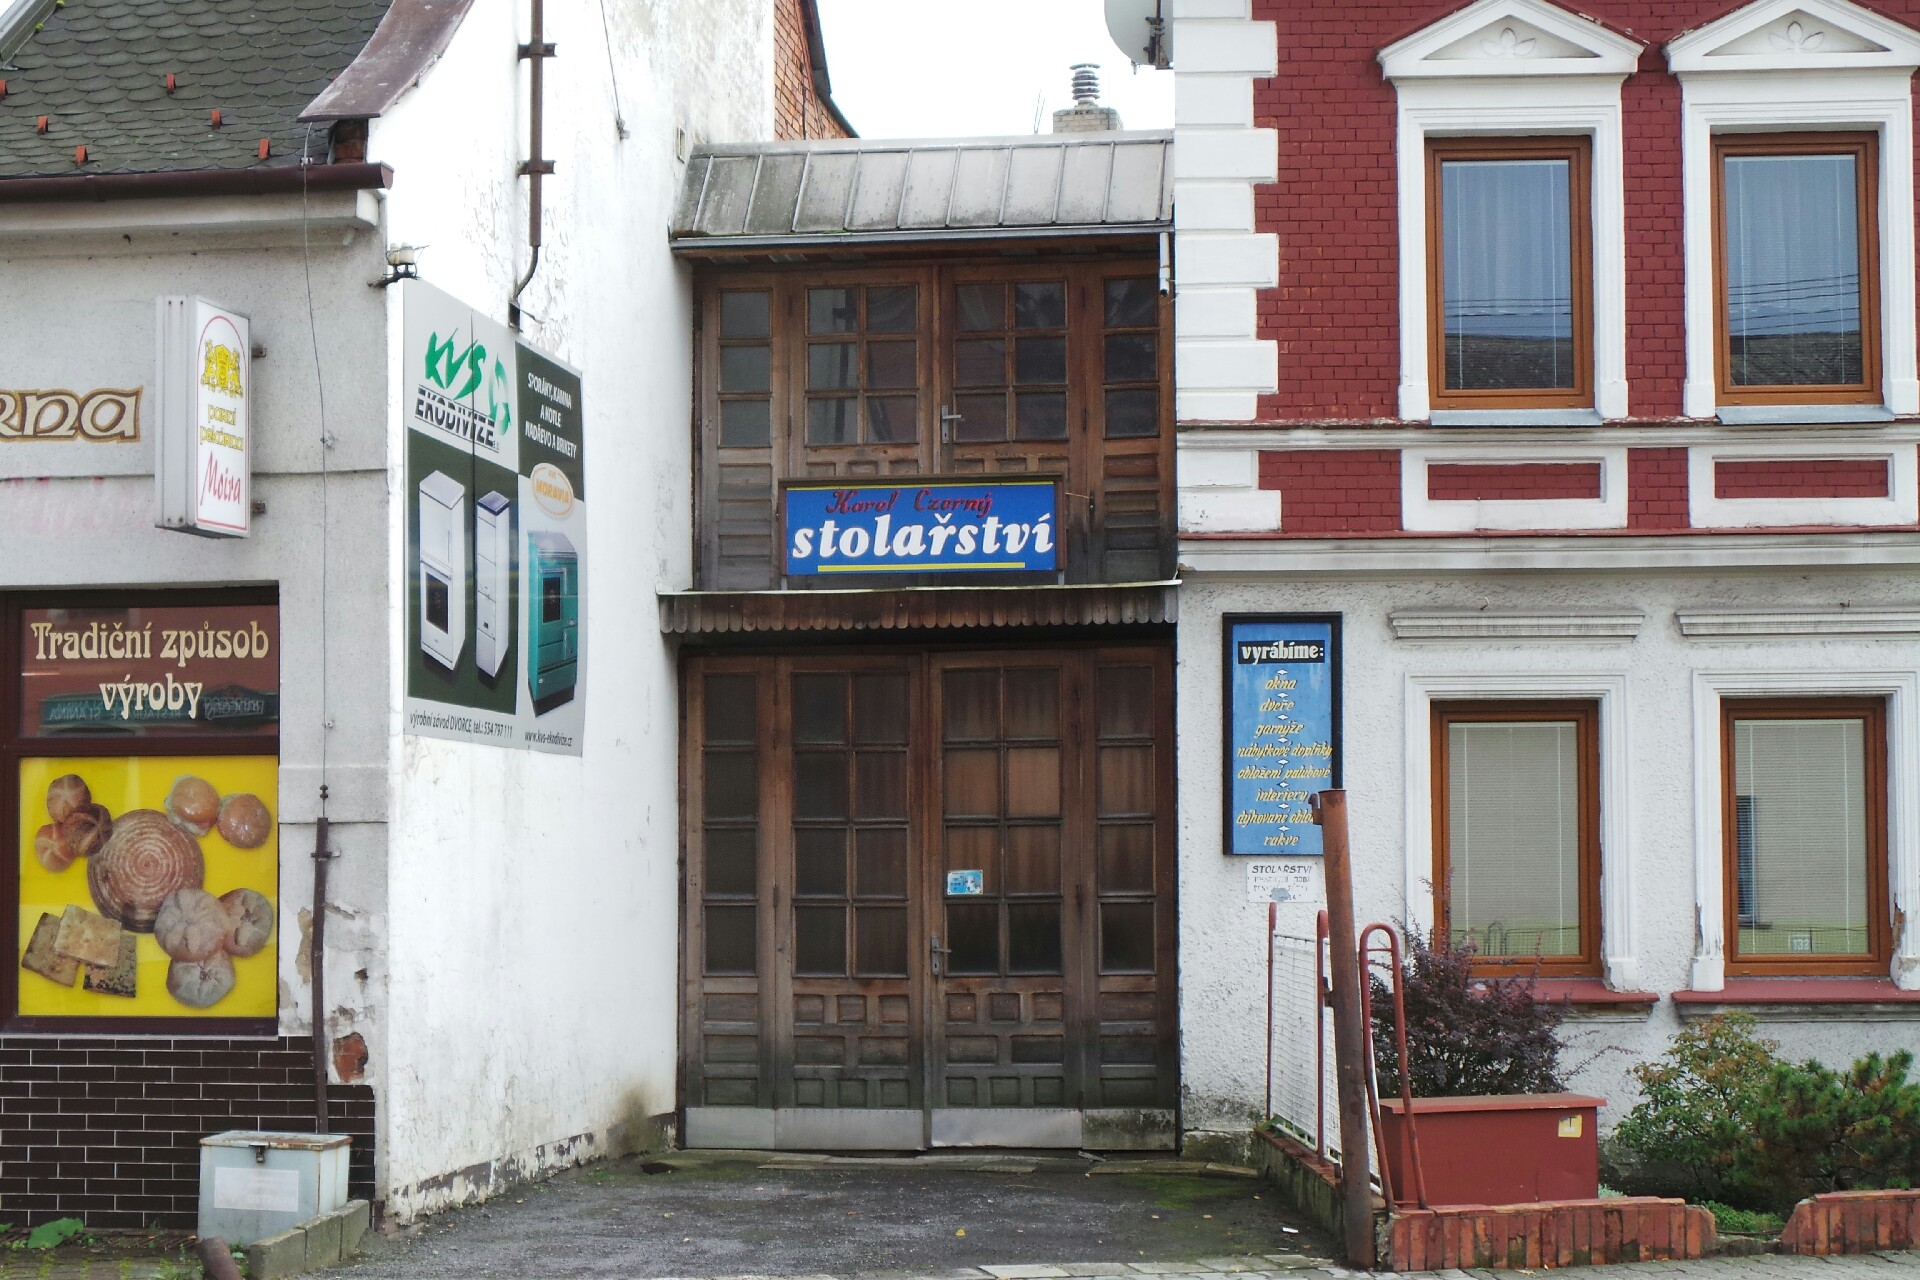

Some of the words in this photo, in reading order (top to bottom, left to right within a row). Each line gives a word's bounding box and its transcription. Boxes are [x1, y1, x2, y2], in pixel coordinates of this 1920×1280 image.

[425, 328, 486, 400] KVS
[414, 386, 496, 447] EKODIVIZE
[200, 451, 241, 506] Moira
[536, 480, 569, 504] MORAVIA
[826, 489, 900, 514] Karel
[792, 513, 1054, 559] stolařství
[30, 621, 153, 660] Tradiční
[160, 620, 269, 667] způsob
[1241, 640, 1324, 665] vyrábíme:
[1265, 674, 1298, 690] okna
[99, 673, 203, 720] výroby
[1260, 698, 1295, 712] dveře
[410, 709, 433, 729] výrobní
[433, 713, 450, 729] závod
[484, 722, 494, 736] 554
[495, 723, 503, 737] 797
[1289, 809, 1314, 825] oblo
[1263, 831, 1299, 847] rakve
